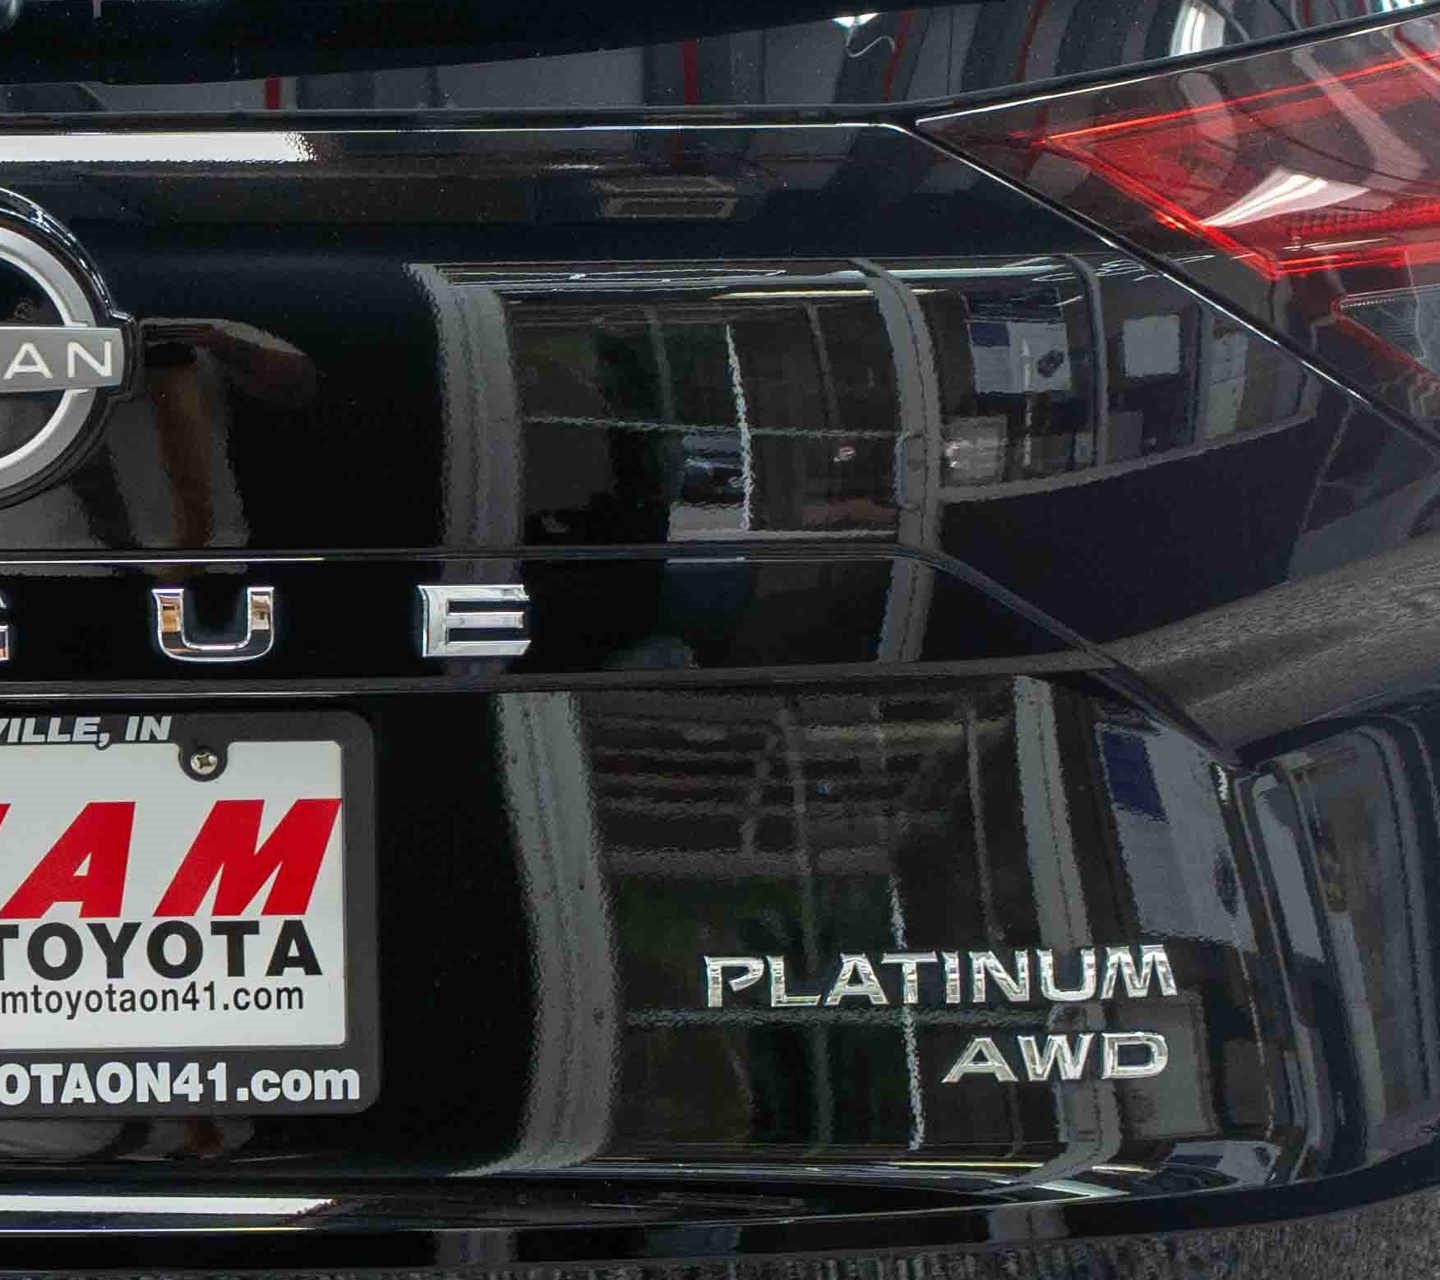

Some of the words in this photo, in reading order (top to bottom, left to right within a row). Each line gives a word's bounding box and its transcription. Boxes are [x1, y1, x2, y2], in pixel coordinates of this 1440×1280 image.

[123, 716, 171, 741] IN
[703, 944, 1178, 1008] PLATINUM
[941, 1031, 1169, 1083] AWD
